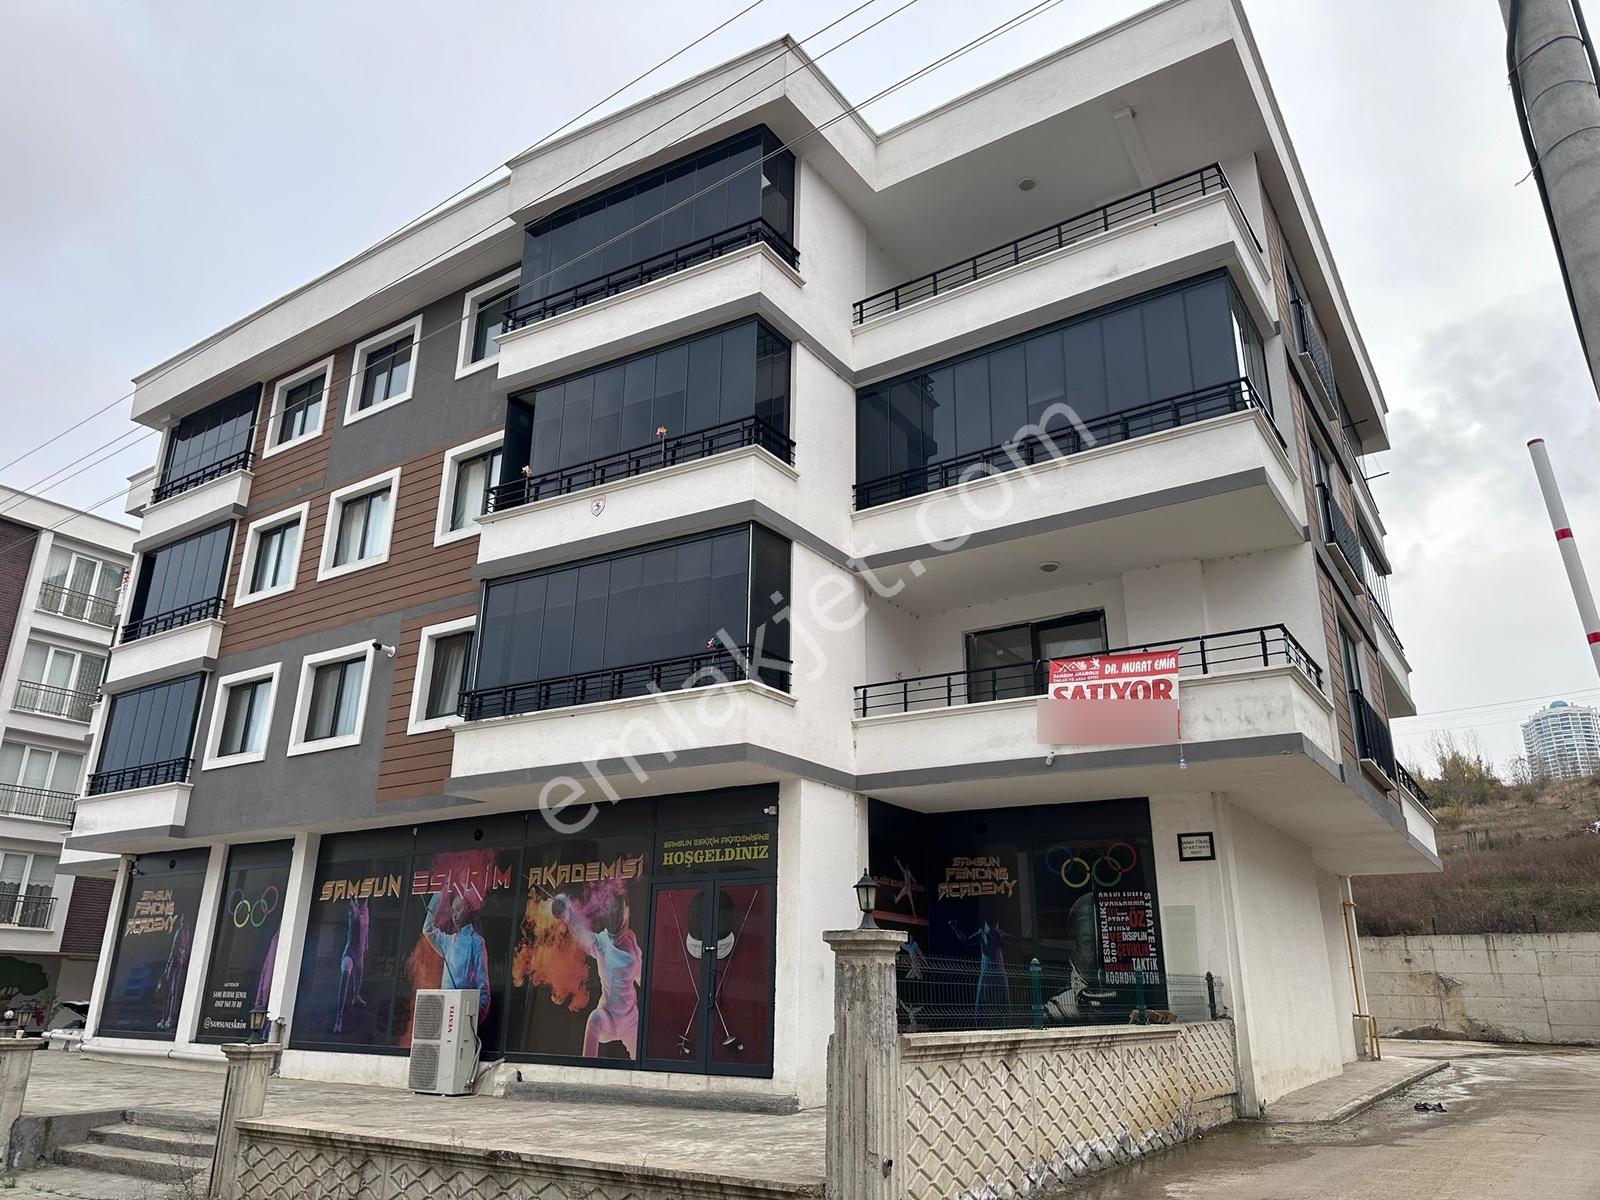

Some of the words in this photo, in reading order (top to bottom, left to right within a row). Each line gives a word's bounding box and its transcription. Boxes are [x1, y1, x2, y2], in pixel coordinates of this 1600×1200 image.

[1104, 663, 1119, 675] DR.
[1121, 659, 1152, 673] MURAT
[1153, 655, 1176, 669] EMİR
[662, 839, 693, 849] SAMSUN
[661, 841, 769, 868] HOŞGELDİNİZ
[952, 856, 1001, 868] SAMSUN
[319, 874, 401, 902] SAMSUN
[411, 862, 513, 901] ESKRİM
[945, 867, 1009, 882] FENCING
[141, 889, 173, 902] SAMSUN
[937, 879, 1018, 901] ACADEMY
[134, 900, 176, 918] FENCING
[124, 915, 179, 937] ACADEMY
[1131, 957, 1158, 971] TAKTİK
[1105, 971, 1160, 985] KOORDİNSYON
[447, 1005, 455, 1033] VESTEL
